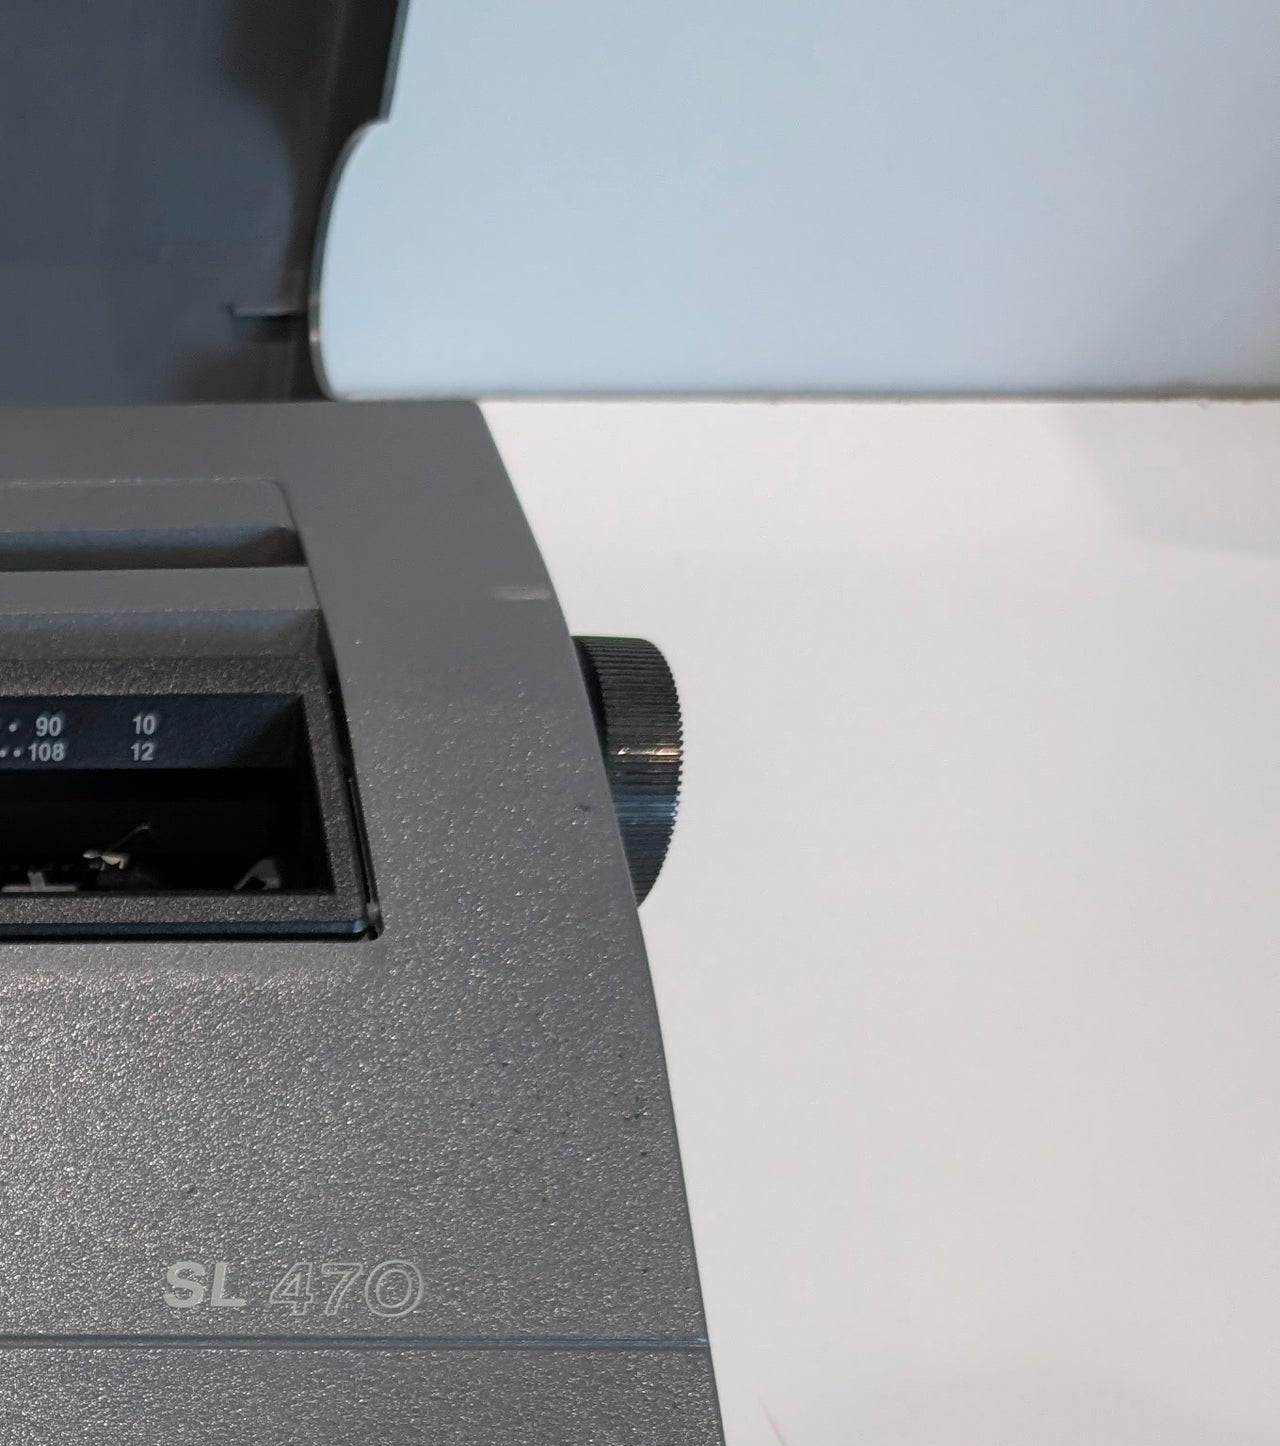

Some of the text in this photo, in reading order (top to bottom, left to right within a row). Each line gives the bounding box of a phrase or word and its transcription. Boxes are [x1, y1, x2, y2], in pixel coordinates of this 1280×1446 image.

[36, 716, 62, 736] 90
[134, 714, 156, 734] 10
[29, 742, 65, 761] 108
[132, 742, 154, 760] 12
[163, 1258, 424, 1317] SL 470
